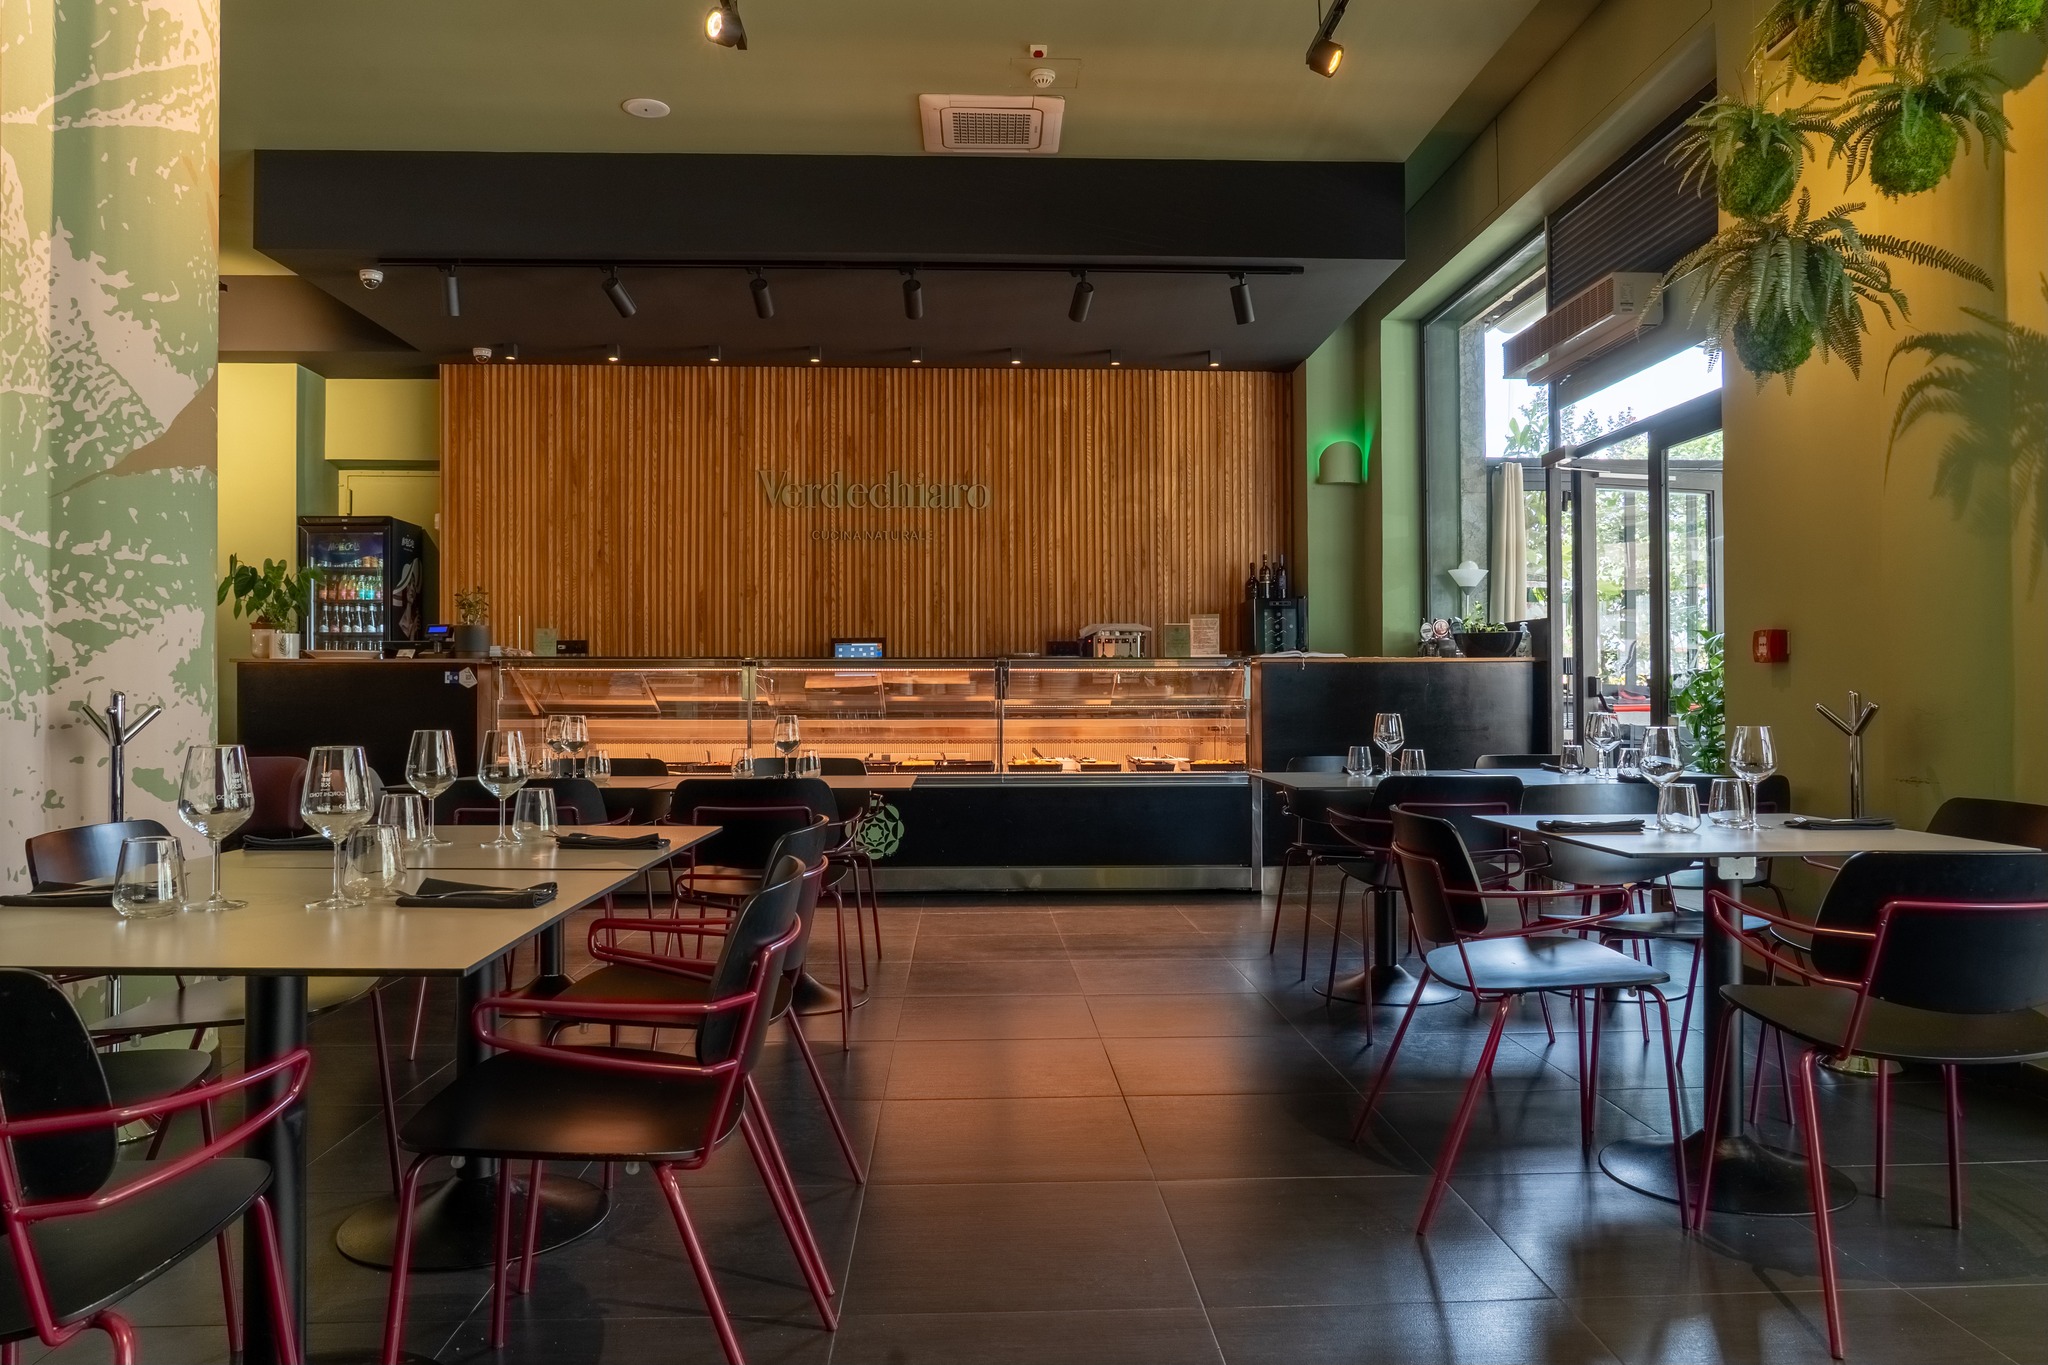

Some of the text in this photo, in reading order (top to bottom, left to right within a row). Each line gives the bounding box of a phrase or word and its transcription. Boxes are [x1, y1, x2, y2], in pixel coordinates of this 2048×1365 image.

[757, 469, 991, 510] Verdechiaro
[811, 530, 934, 541] CUCINA NATURALE
